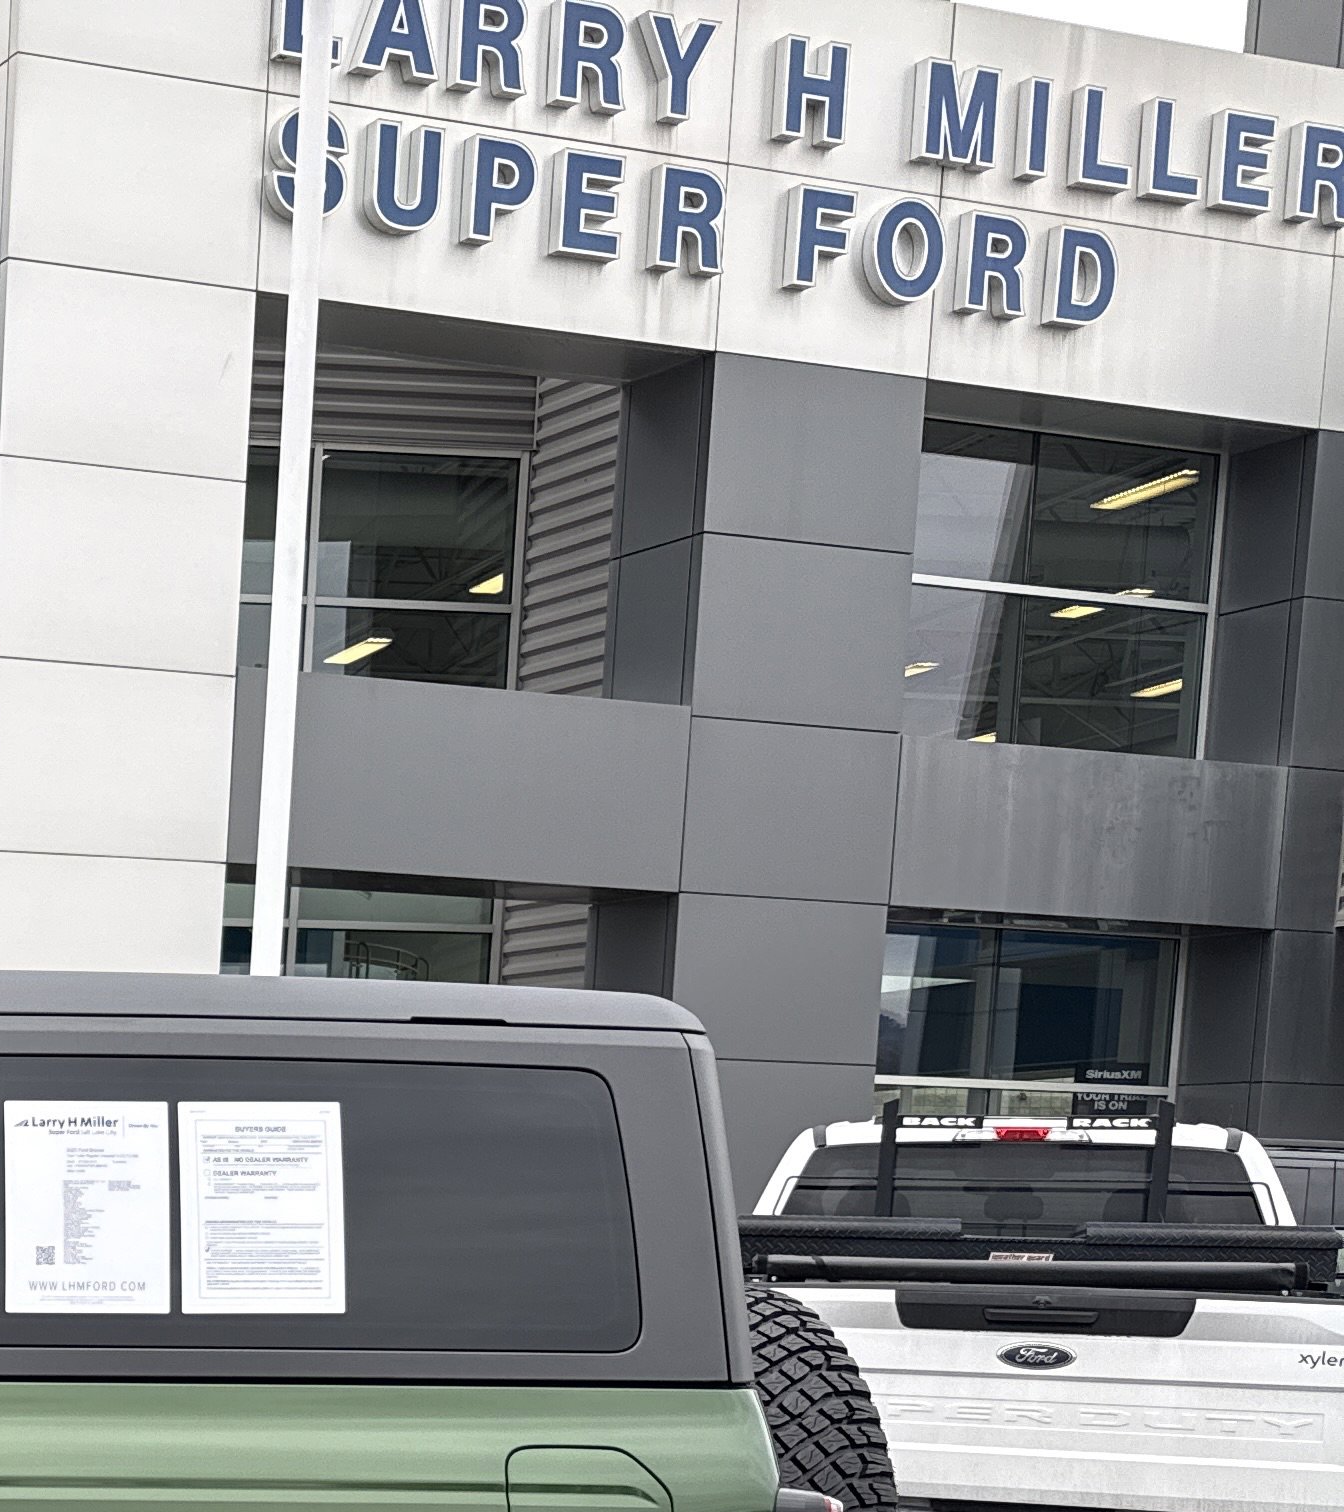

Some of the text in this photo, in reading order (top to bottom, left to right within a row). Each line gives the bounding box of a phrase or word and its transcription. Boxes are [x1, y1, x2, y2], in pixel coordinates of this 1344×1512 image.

[769, 34, 851, 149] H
[912, 57, 1344, 228] MILLER
[265, 108, 1118, 330] SUPER FORD
[1085, 1069, 1143, 1080] SiriusXM
[1094, 1101, 1128, 1111] IS ON
[32, 1116, 65, 1129] Larry
[68, 1117, 77, 1127] H
[80, 1116, 119, 1128] Miller
[902, 1117, 1152, 1128] BACK RACK
[1078, 1409, 1314, 1437] DUTY
